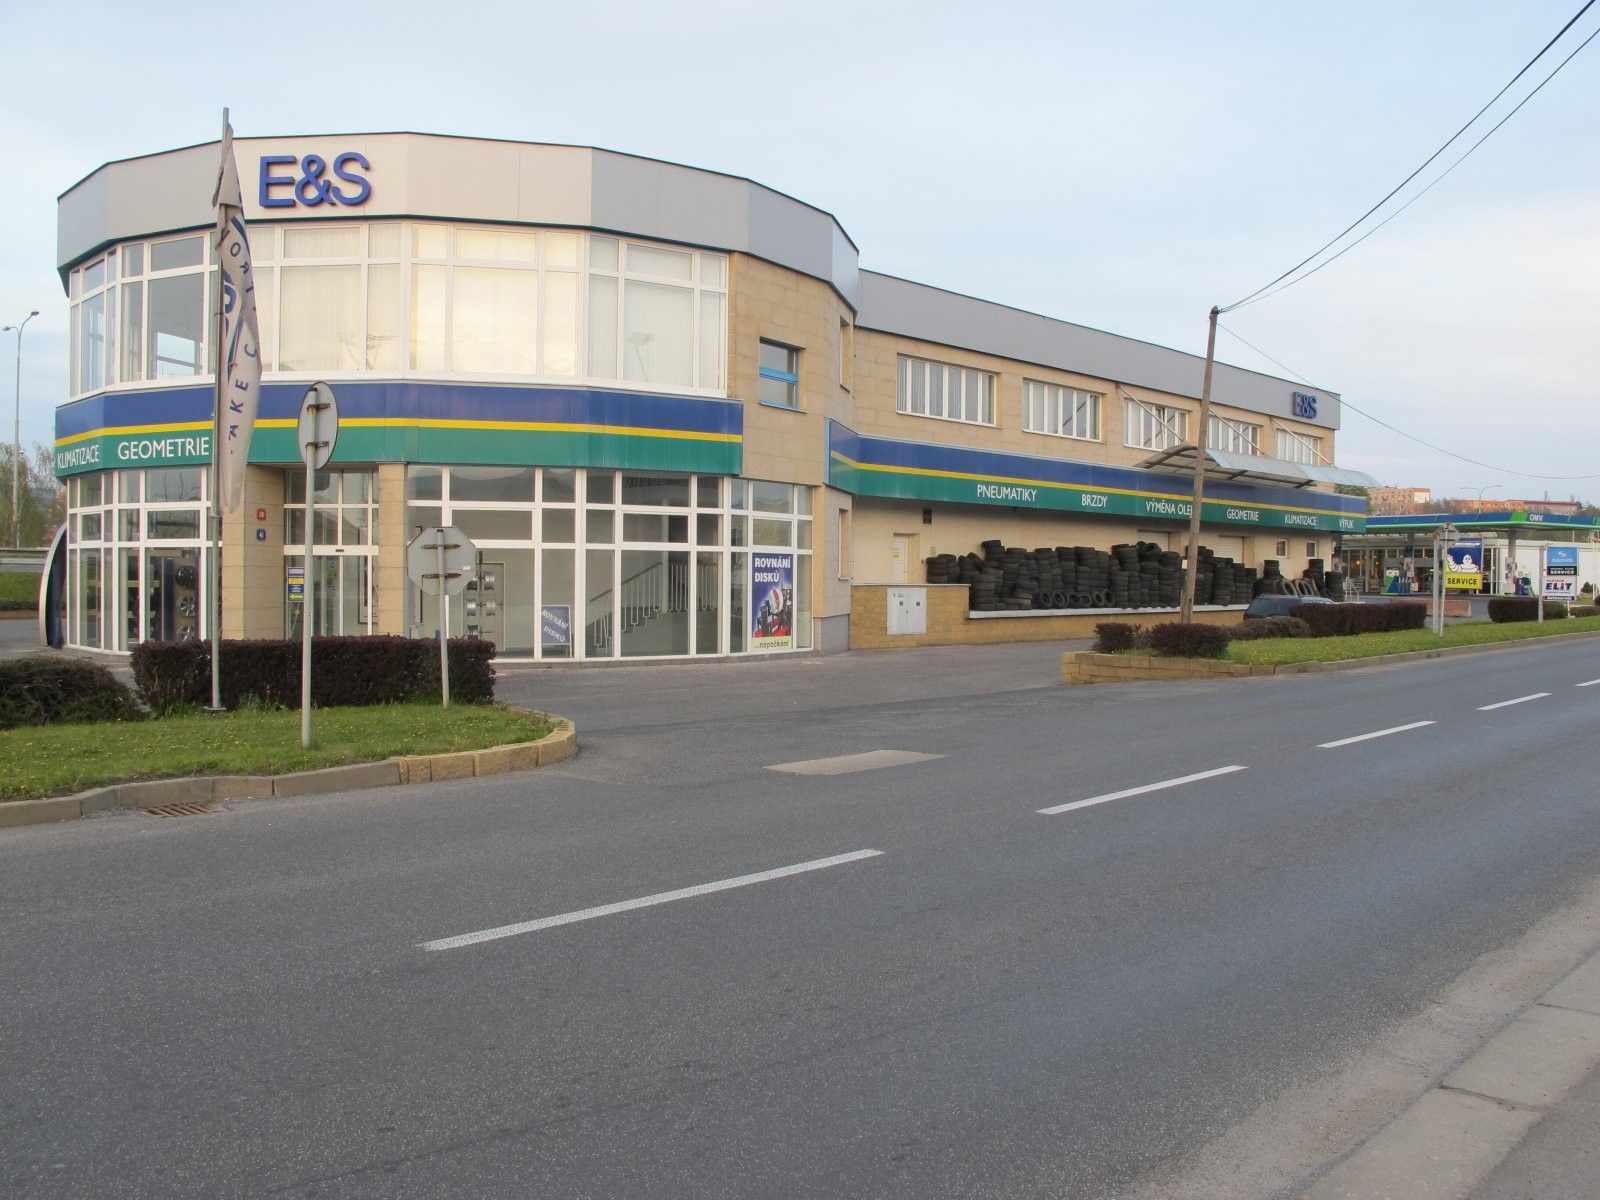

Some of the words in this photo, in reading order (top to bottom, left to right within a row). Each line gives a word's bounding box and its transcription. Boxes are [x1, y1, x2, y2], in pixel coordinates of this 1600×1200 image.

[258, 151, 371, 208] E&S
[1292, 391, 1318, 419] E&S
[117, 436, 210, 460] GEOMETRIE
[57, 444, 100, 470] KLIMATIZACE
[976, 484, 1038, 502] PNEUMATIKY
[1081, 494, 1108, 508] BRZDY
[1145, 498, 1176, 515] VÝMĚNA
[1226, 508, 1259, 522] GEOMETRIE
[1284, 513, 1317, 526] KLIMATIZACE
[1529, 513, 1544, 522] OMV
[1338, 516, 1354, 529] VÝFUK
[754, 556, 791, 569] ROVNÁNÍ
[754, 571, 780, 584] DISKŮ
[1447, 577, 1478, 585] SERVICE
